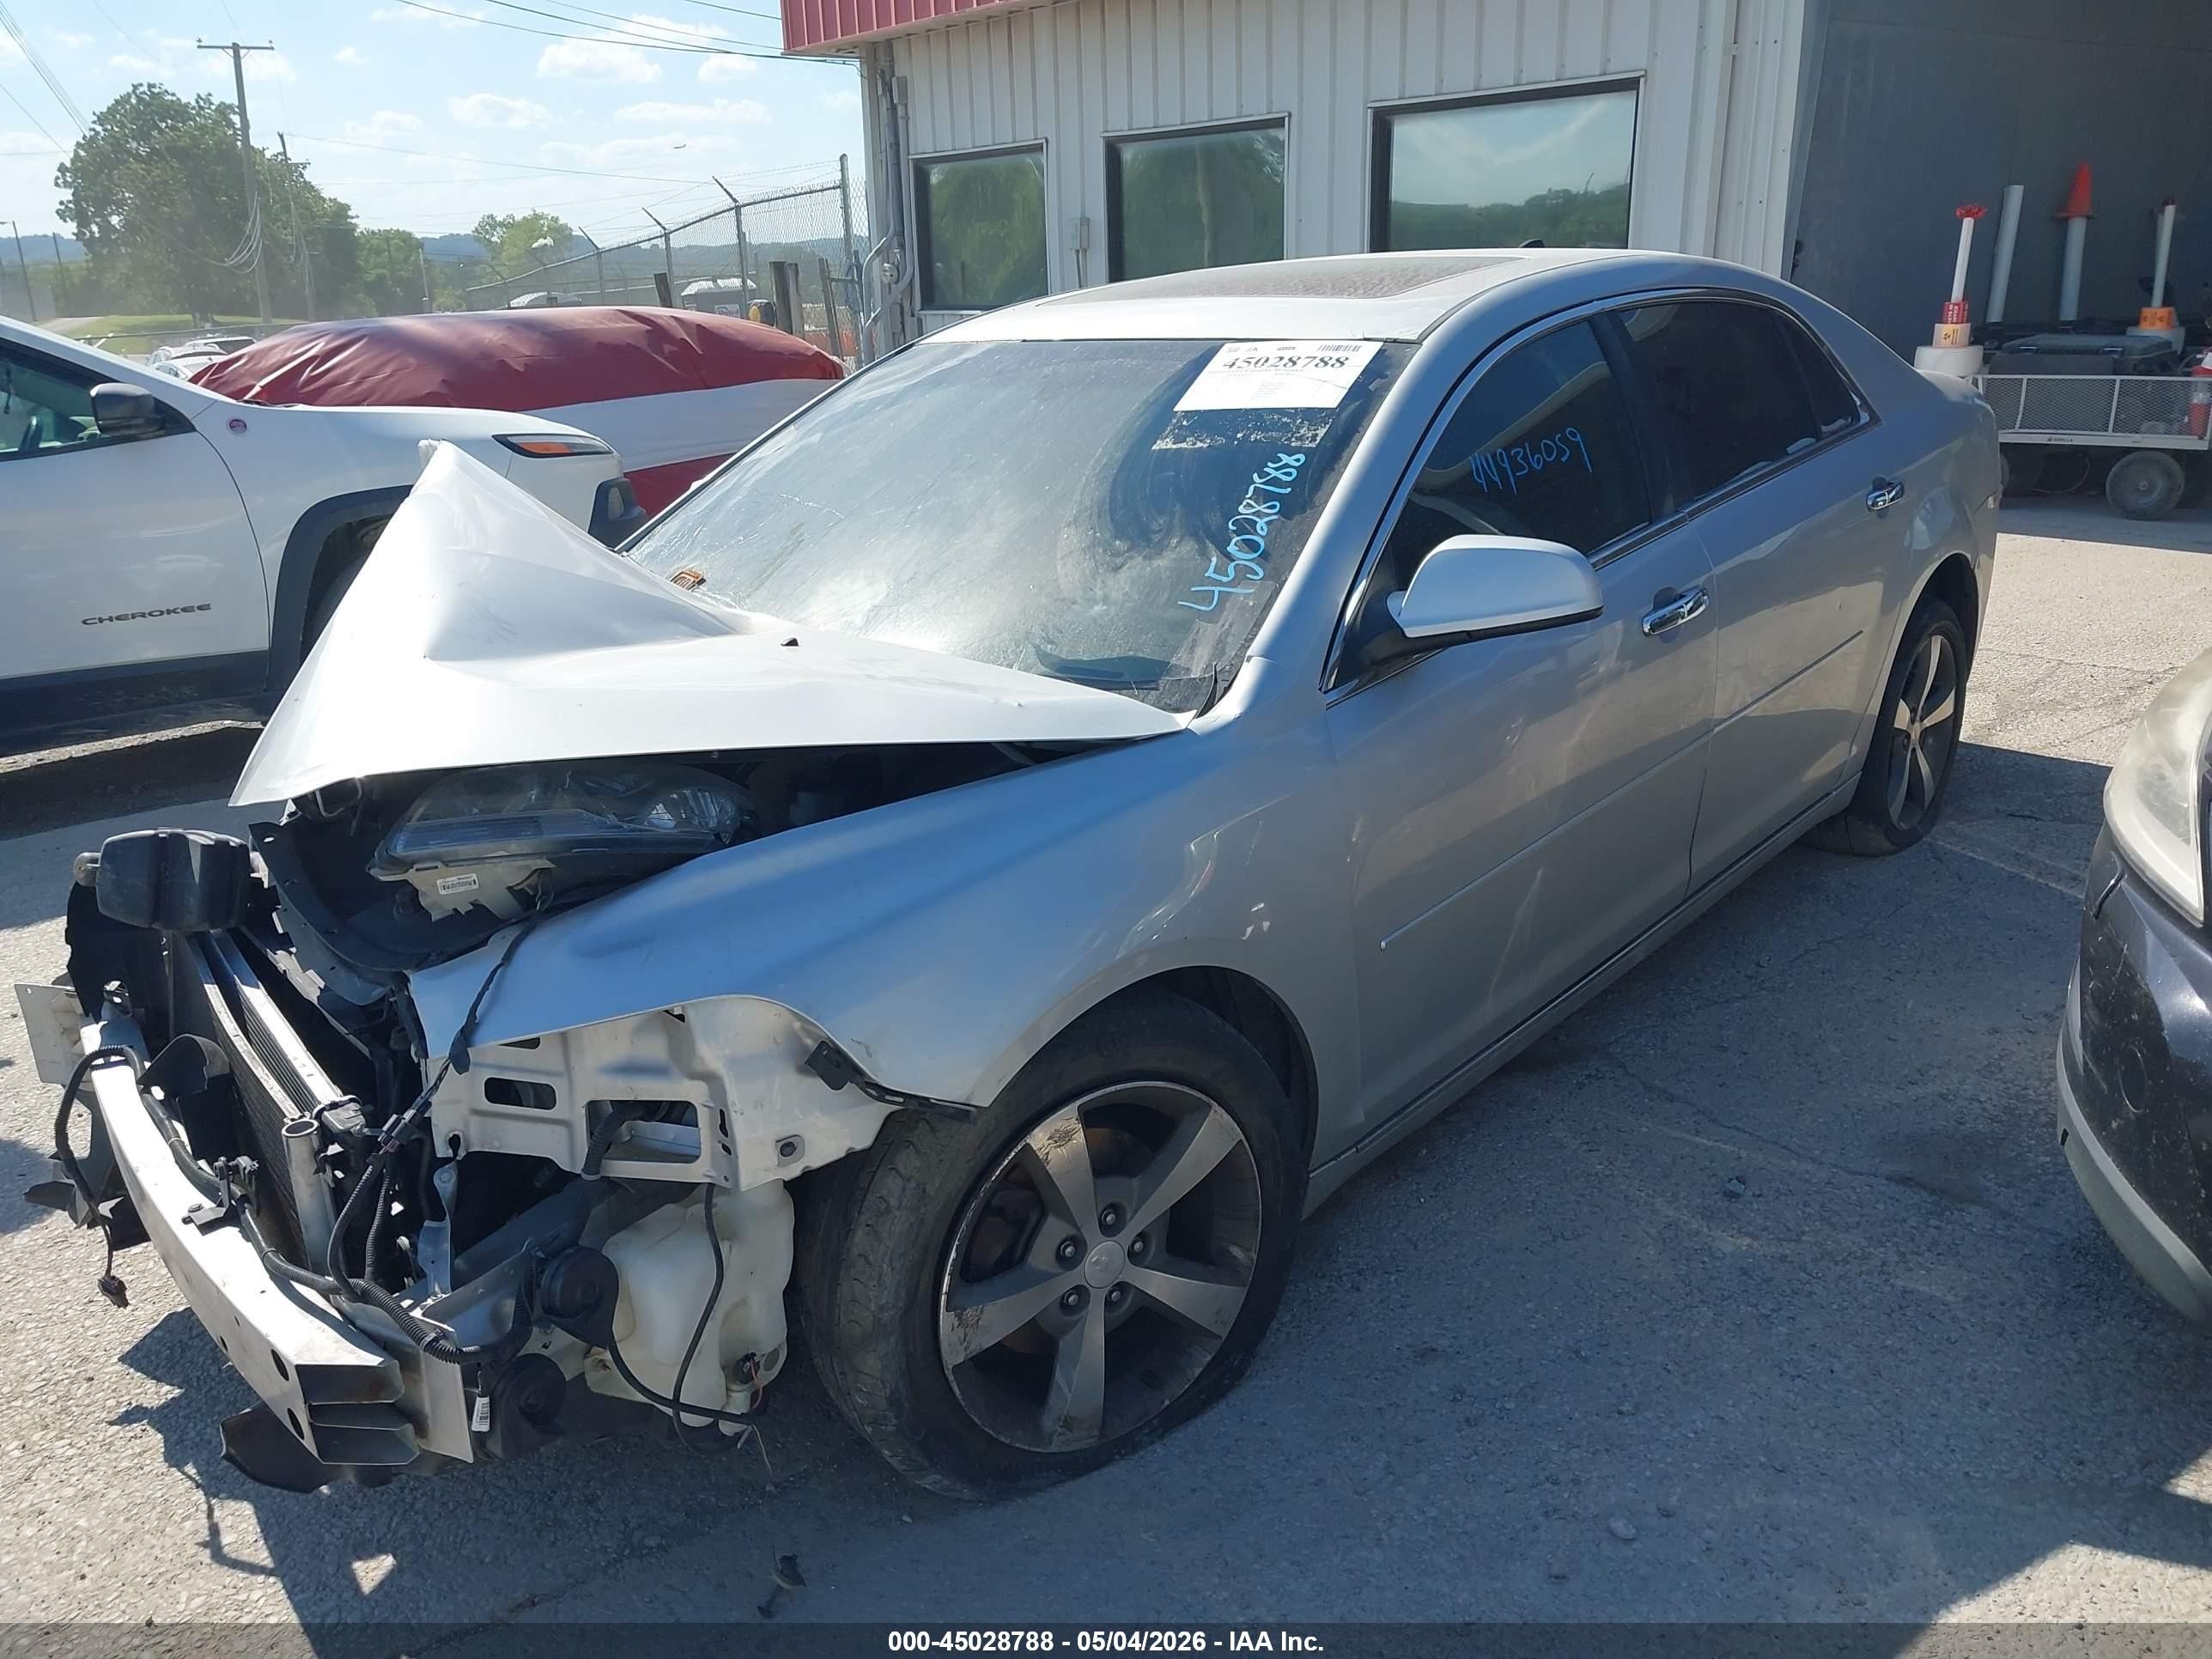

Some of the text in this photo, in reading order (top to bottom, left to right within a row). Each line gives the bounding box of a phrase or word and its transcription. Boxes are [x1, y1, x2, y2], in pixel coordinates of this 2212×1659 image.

[1223, 356, 1350, 369] 45028788
[1177, 453, 1306, 611] 45028788
[82, 603, 212, 626] CHEROKEE
